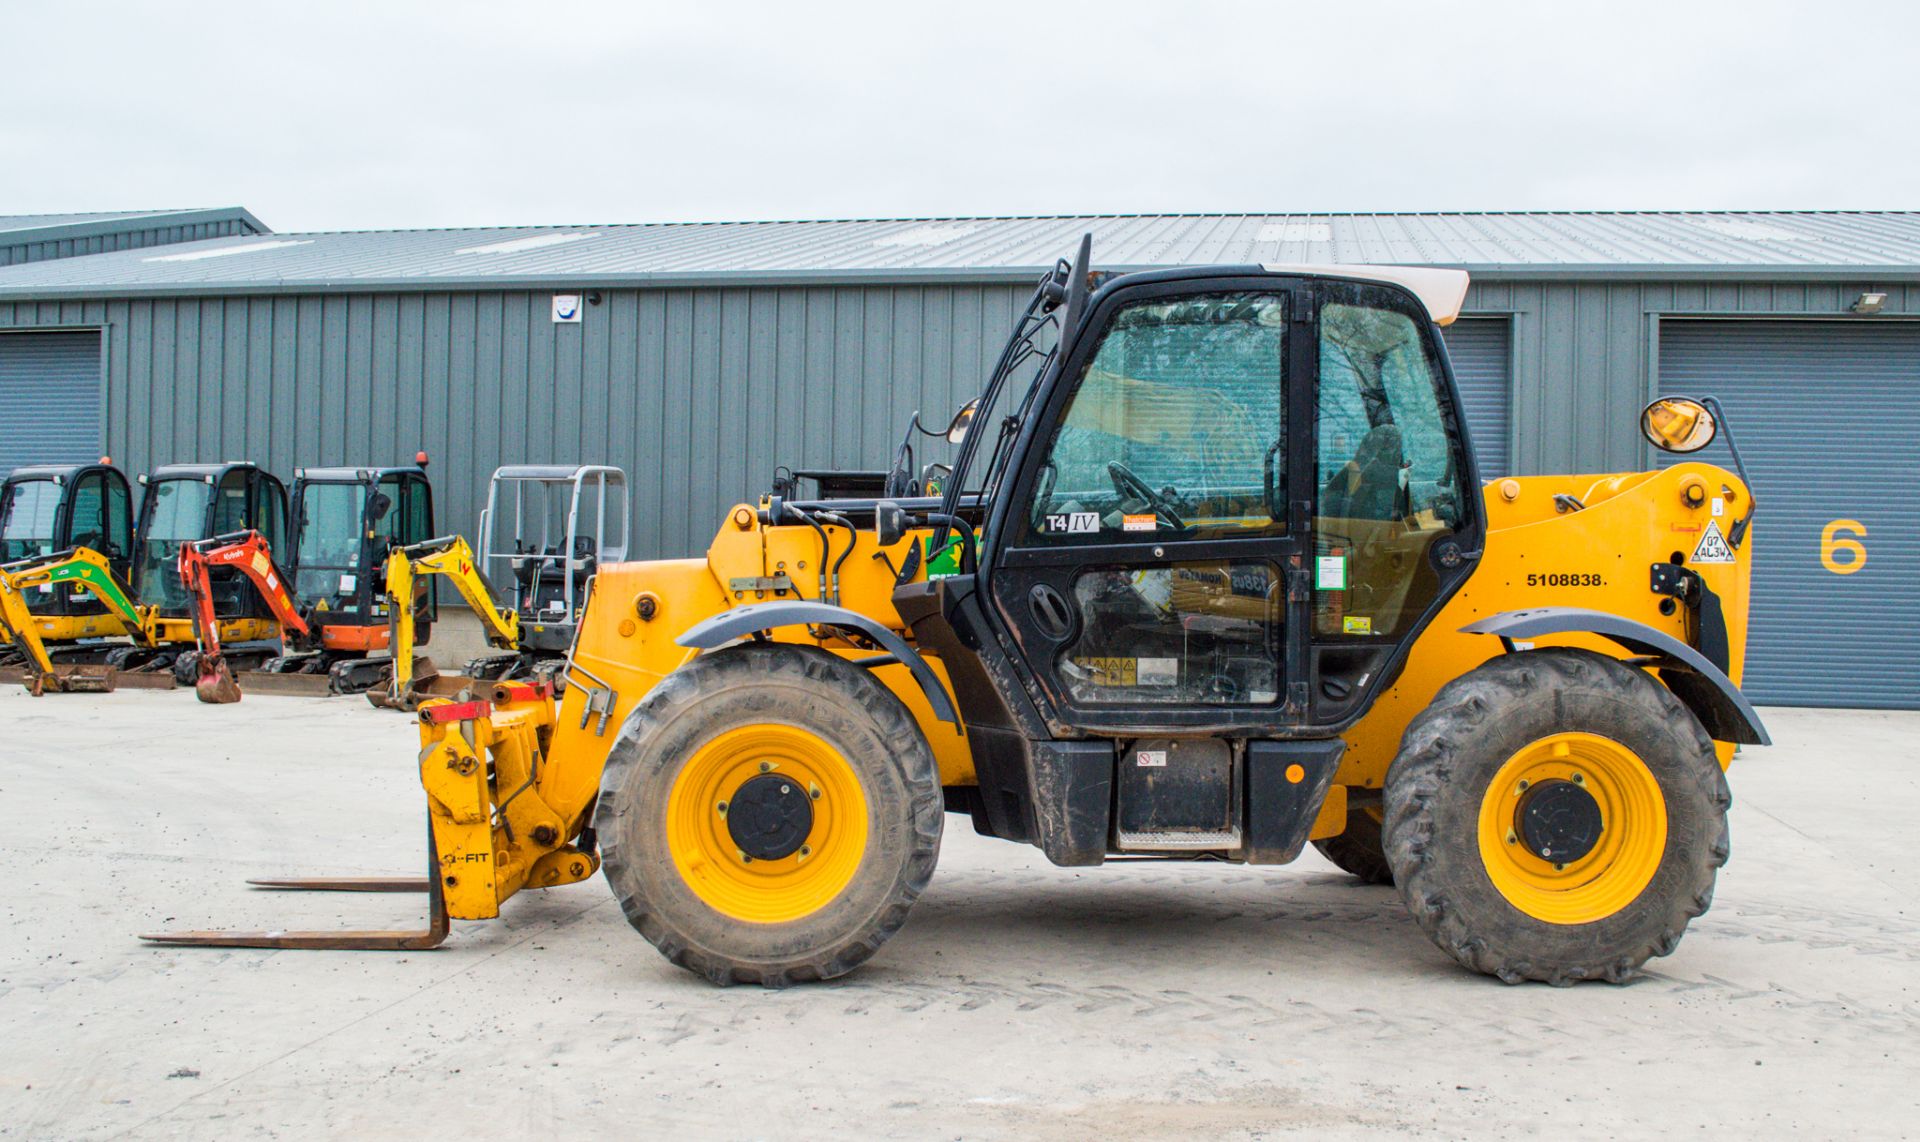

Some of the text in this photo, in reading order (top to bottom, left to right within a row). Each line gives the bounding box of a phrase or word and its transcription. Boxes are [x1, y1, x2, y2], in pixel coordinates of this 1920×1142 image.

[1046, 515, 1068, 531] T4
[1821, 519, 1867, 575] 6
[1527, 574, 1602, 587] 5108838
